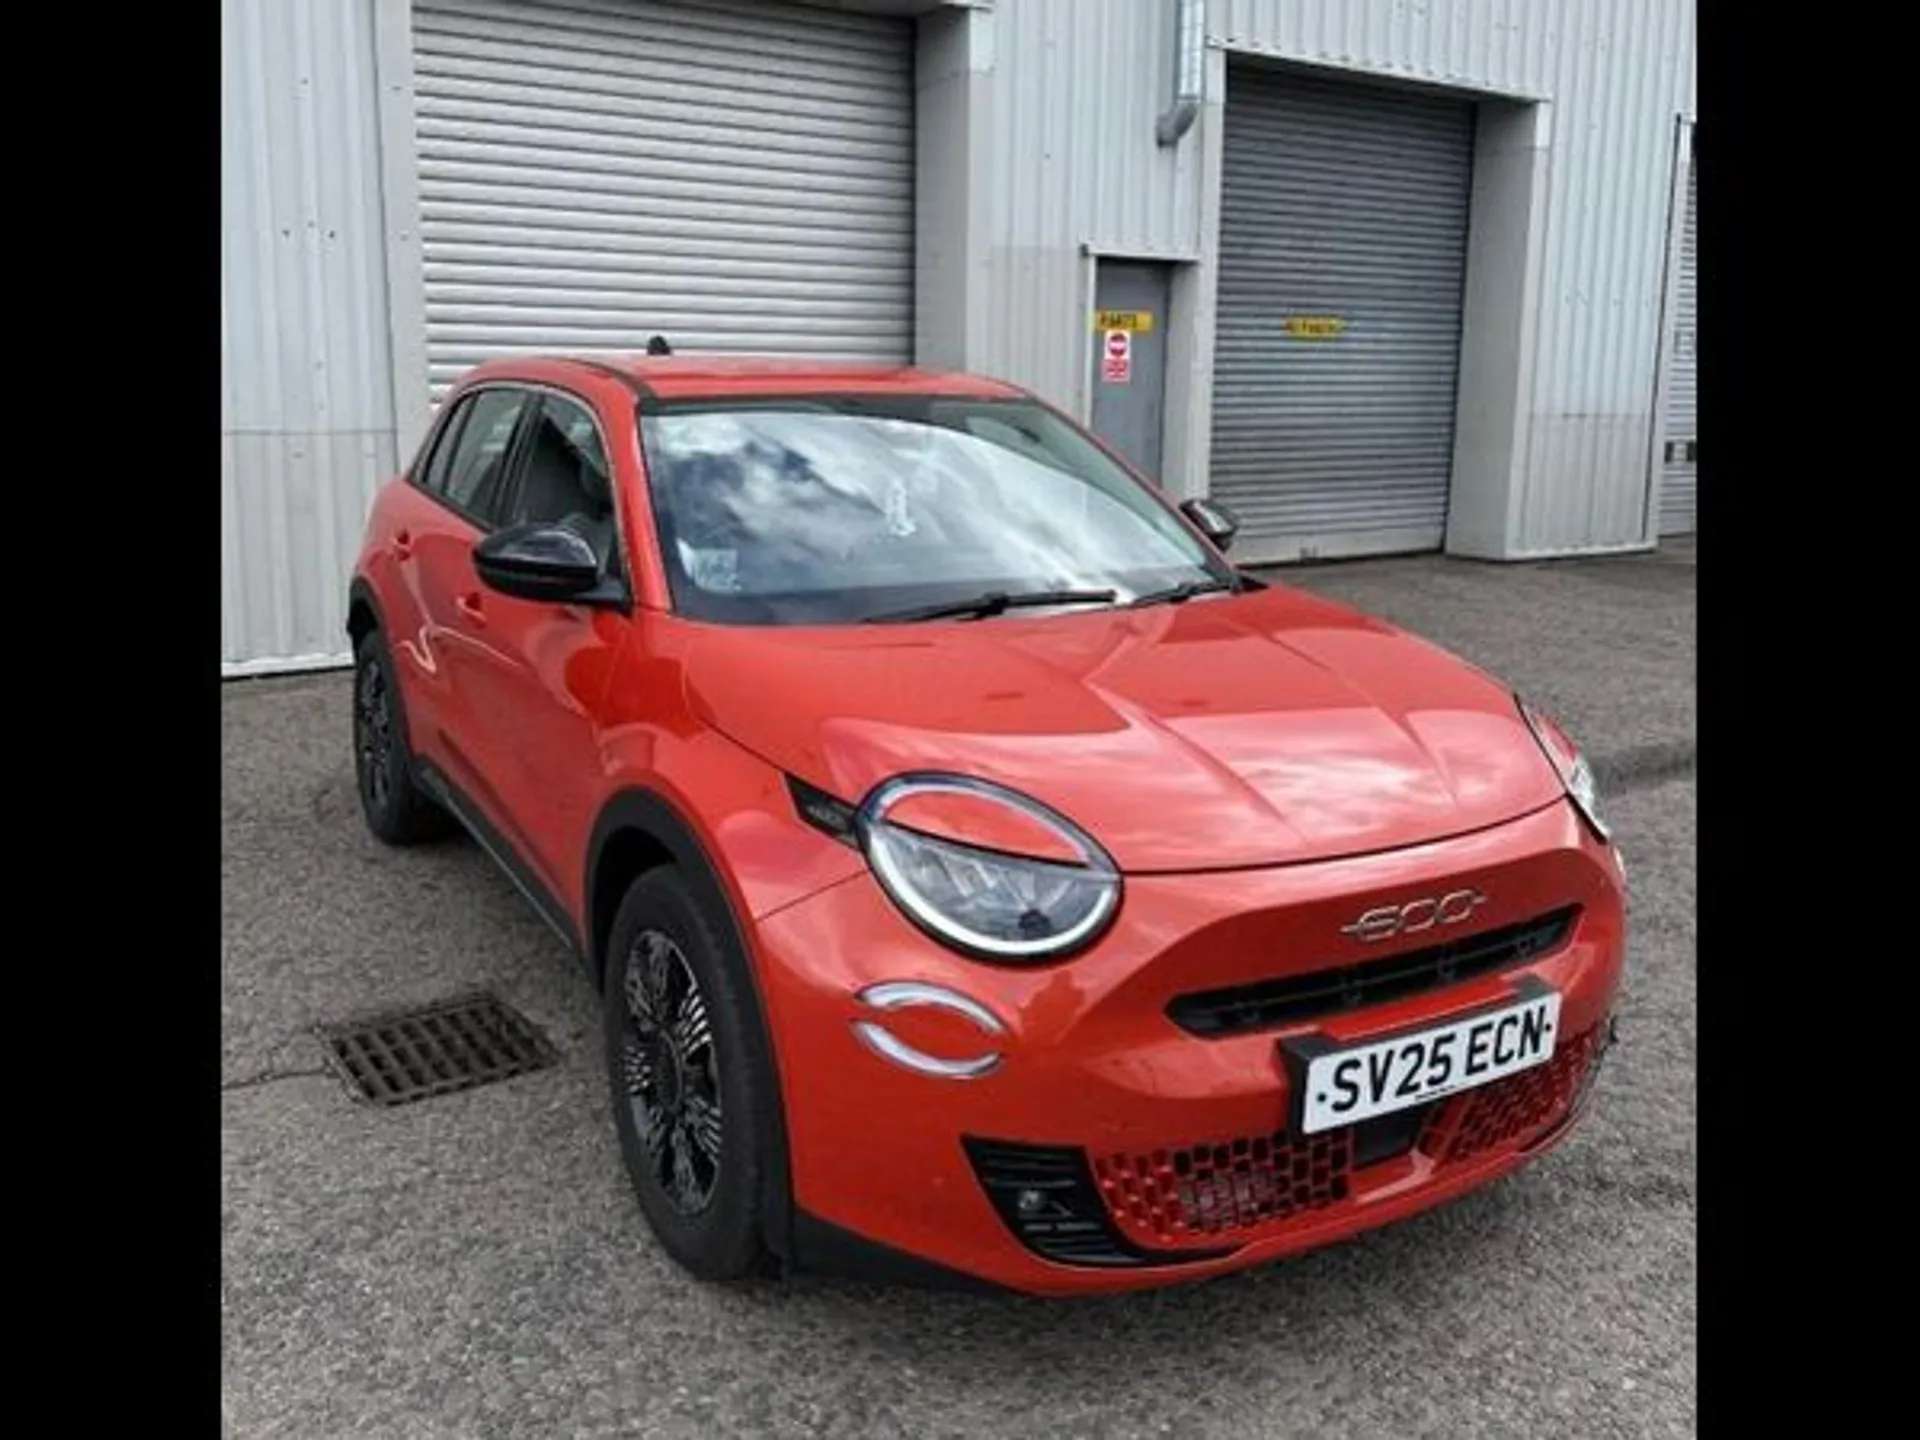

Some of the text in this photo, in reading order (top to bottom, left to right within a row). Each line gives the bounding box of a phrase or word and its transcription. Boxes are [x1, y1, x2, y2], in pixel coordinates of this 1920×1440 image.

[1341, 889, 1486, 942] 600
[1331, 1005, 1546, 1112] SV25 ECN
